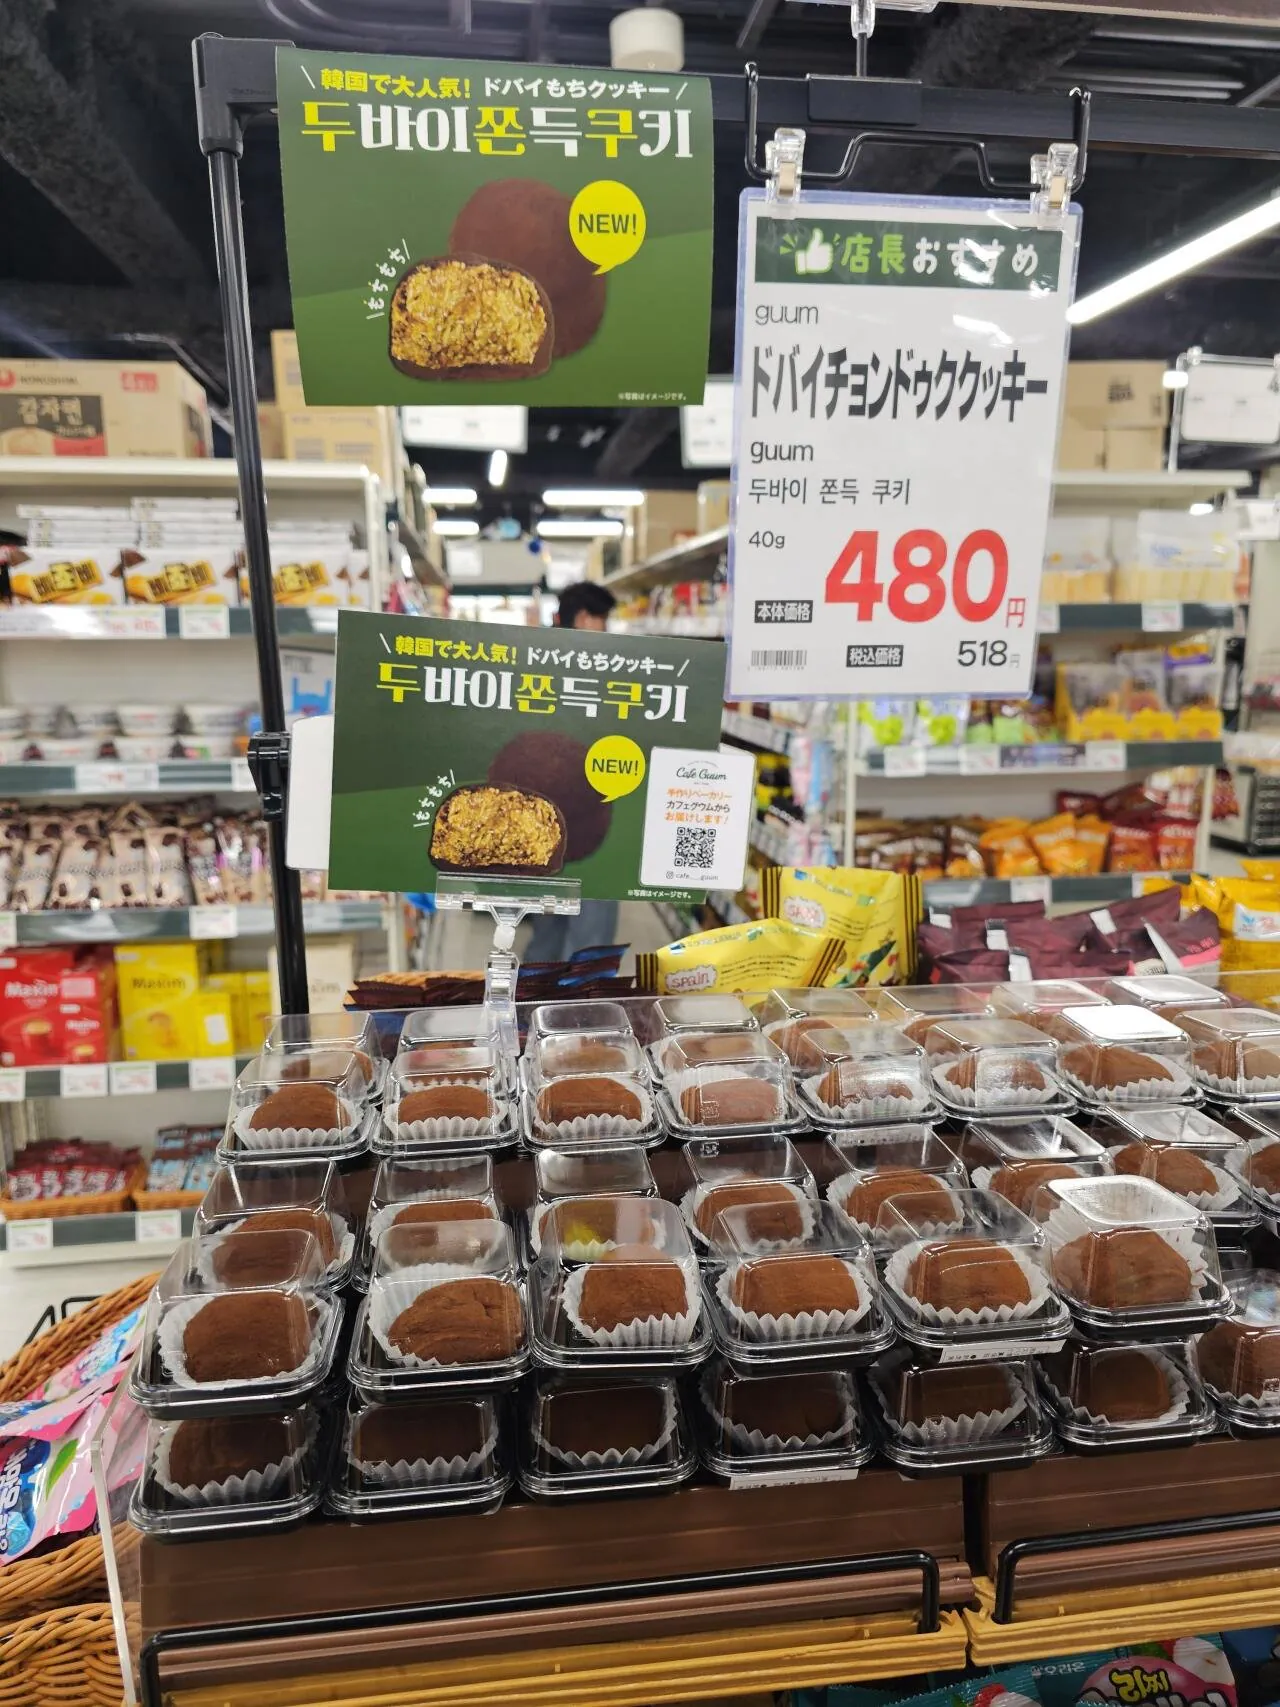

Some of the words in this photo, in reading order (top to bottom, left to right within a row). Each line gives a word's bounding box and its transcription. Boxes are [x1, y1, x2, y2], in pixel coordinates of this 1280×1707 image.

[483, 77, 670, 100] ドバイもちクッキー
[301, 100, 694, 158] 두바이쫀득쿠키
[577, 212, 638, 236] NEW!
[754, 303, 819, 326] guum
[751, 344, 1048, 423] ドバイチョンドゥククッキー
[750, 441, 815, 465] guum
[748, 477, 808, 505] 두바이
[818, 478, 860, 505] 쫀득
[872, 478, 911, 505] 쿠키
[748, 531, 786, 549] 40g
[824, 528, 1010, 623] 480
[1005, 597, 1027, 629] 円
[756, 602, 812, 623] 本体価格
[526, 646, 675, 675] ドバイもちクッキー
[849, 647, 901, 666] 税込価格
[957, 640, 1008, 668] 518
[376, 661, 689, 724] 두바이쫀득쿠키
[592, 756, 639, 777] NEW!
[676, 767, 698, 780] Cafe
[666, 800, 731, 813] カフェグウムから
